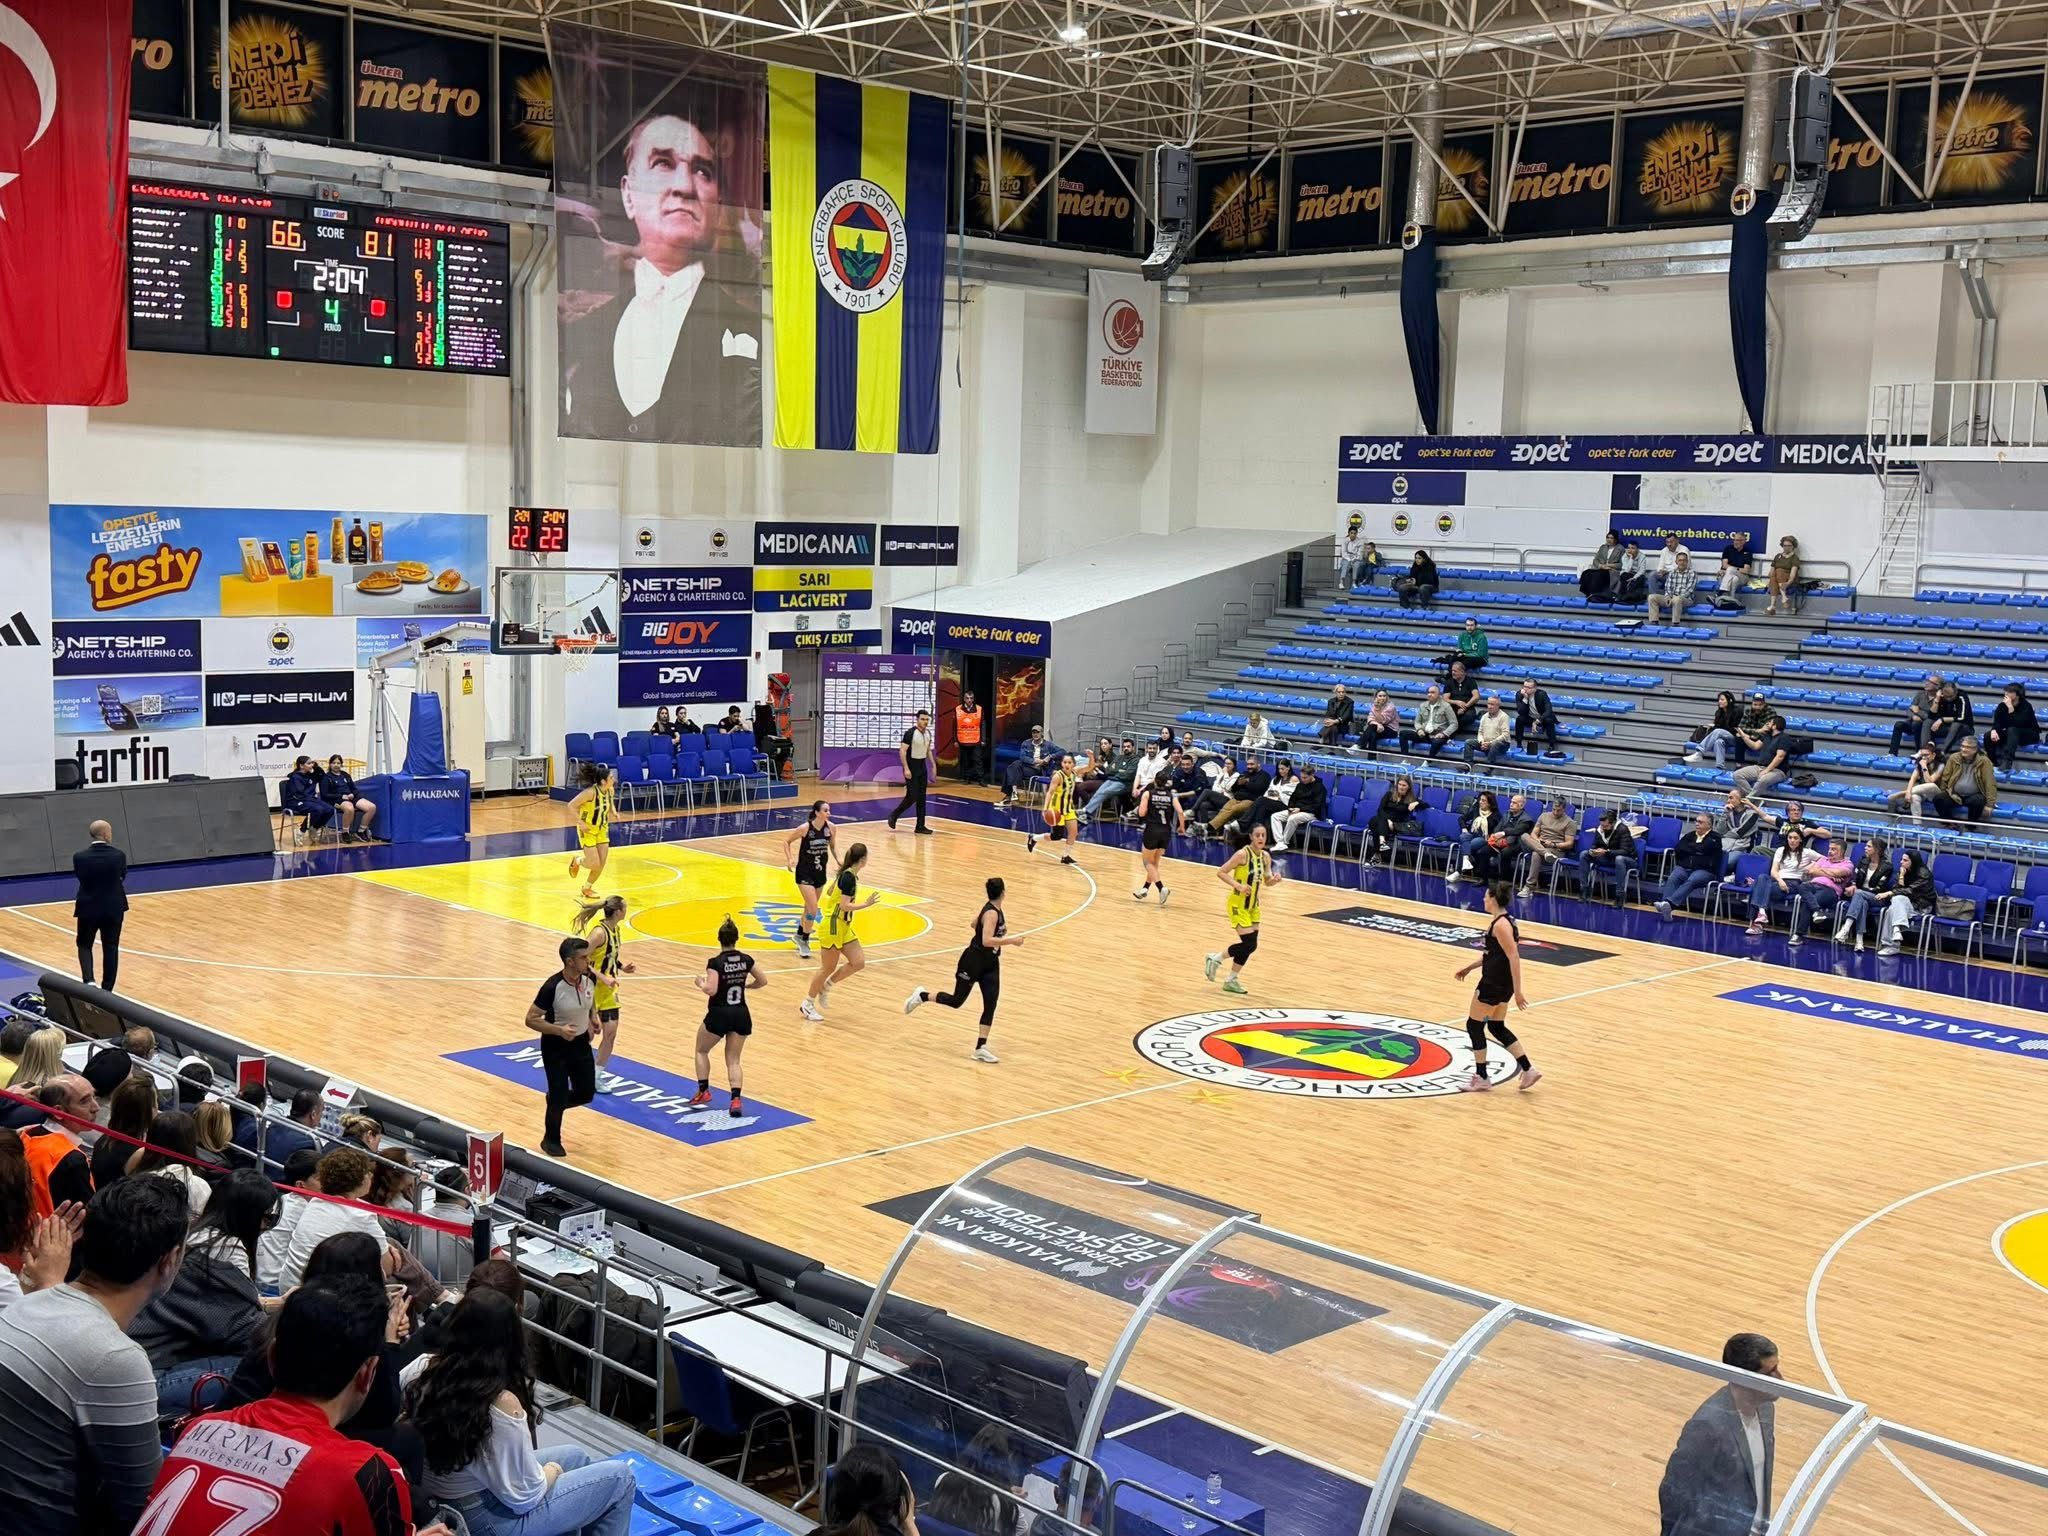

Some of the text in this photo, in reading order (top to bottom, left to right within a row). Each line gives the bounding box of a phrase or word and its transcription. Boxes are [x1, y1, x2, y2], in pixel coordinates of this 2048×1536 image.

[360, 59, 403, 80] ÜLKER
[240, 80, 312, 109] DEMEZ
[357, 77, 481, 117] metro
[1300, 184, 1329, 197] ÜLKER
[1509, 162, 1612, 203] metro
[860, 185, 893, 217] SPOR
[1058, 189, 1130, 219] metro
[1296, 186, 1382, 222] metro
[272, 220, 301, 247] 66
[317, 226, 345, 239] SCORE
[815, 184, 855, 278] FENERBAHÇE
[365, 230, 393, 256] 81
[888, 219, 907, 286] KULÜBÜ
[324, 258, 339, 267] TIME
[313, 265, 364, 294] 2:04
[845, 292, 872, 308] 1907
[325, 299, 339, 324] 4
[324, 323, 341, 332] PERIOD
[1101, 356, 1143, 372] TÜRKİYE
[1101, 370, 1142, 381] BASKETBOL
[1101, 378, 1142, 388] FEDERASYONU
[1349, 441, 1403, 463] opet
[1452, 447, 1471, 457] fark
[1473, 447, 1496, 457] eder
[1511, 441, 1572, 465] opet
[1628, 447, 1649, 458] fark
[1652, 448, 1676, 458] eder
[1694, 440, 1764, 466] opet
[1781, 444, 1890, 464] MEDICAN
[102, 511, 159, 531] OPET'TE
[542, 511, 565, 524] 2:04
[91, 518, 181, 544] LEZZETLERİN
[512, 526, 563, 549] 22 22
[106, 532, 164, 554] ENFESTİ
[759, 533, 858, 554] MEDICANA
[90, 545, 200, 600] fasty
[799, 573, 830, 586] SARI
[633, 578, 722, 591] NETSHIP
[633, 591, 746, 602] AGENCY & CHARTERING CO.
[779, 593, 847, 608] LACİVERT
[67, 636, 166, 649] NETSHIP
[795, 634, 821, 647] ÇIKIŞ
[832, 633, 853, 644] EXIT
[900, 619, 1041, 645] opet opet'se fark eder
[67, 648, 193, 659] AGENCY & CHARTERING CO.
[268, 656, 295, 667] opet
[659, 666, 701, 684] DSV
[236, 691, 347, 704] FENERIUM
[643, 691, 660, 699] Global
[661, 690, 684, 698] Transport
[257, 732, 307, 750] DSV
[76, 736, 169, 789] tarfin
[413, 789, 460, 799] HALKBANK
[727, 985, 742, 1005] 0
[1155, 1008, 1289, 1038] KULÜBÜ
[1754, 990, 2020, 1044] HALKBANK
[1372, 1018, 1470, 1043] 1907
[1151, 1041, 1231, 1076] SPOR
[474, 1152, 484, 1179] 5
[960, 1206, 1054, 1241] KADINLAR
[984, 1200, 1158, 1264] BASKETBOL
[935, 1213, 1075, 1266] HALKBANK
[184, 1445, 268, 1476] BAHÇEŞEHİR
